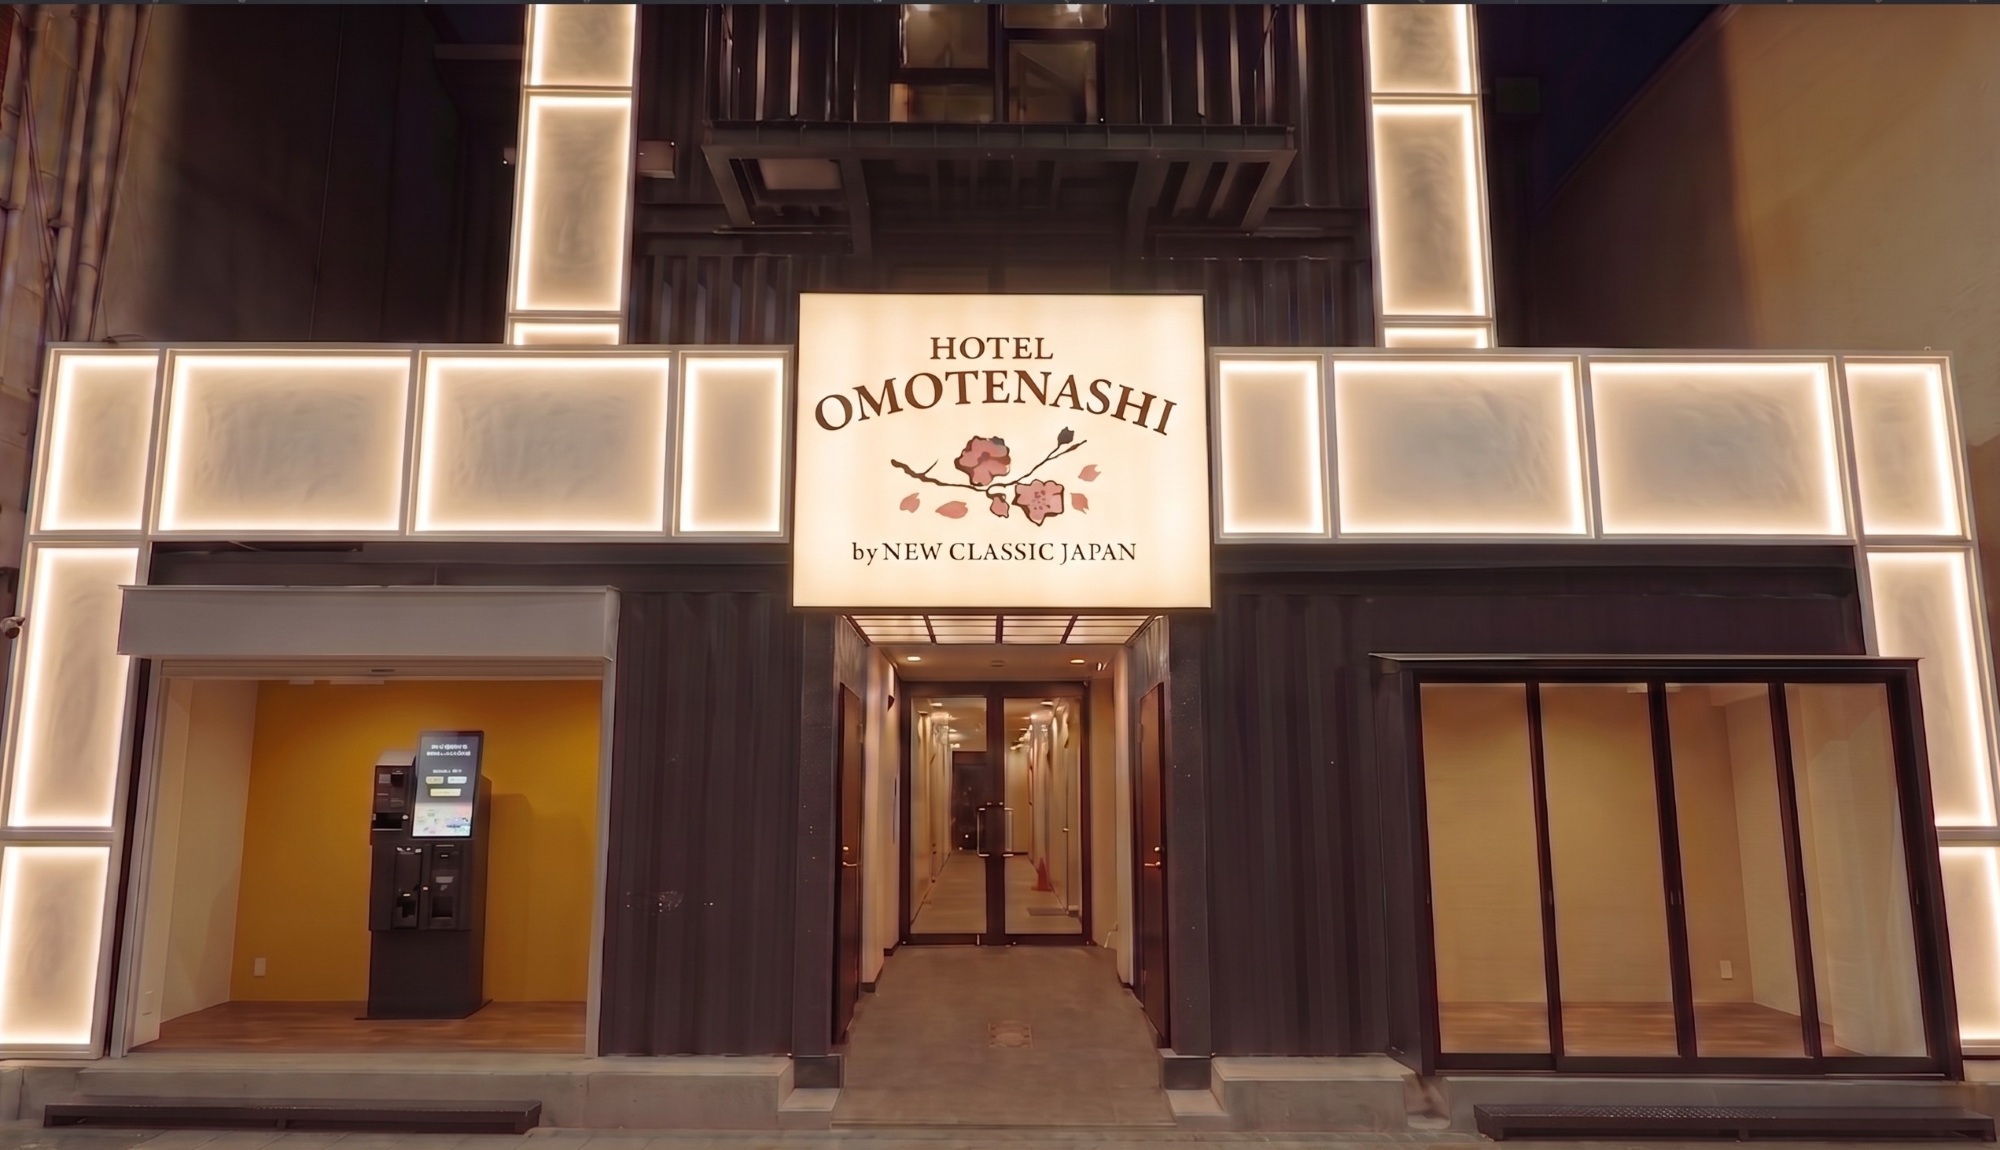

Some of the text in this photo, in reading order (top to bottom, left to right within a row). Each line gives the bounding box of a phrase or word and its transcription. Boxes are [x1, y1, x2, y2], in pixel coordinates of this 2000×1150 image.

[930, 337, 1054, 360] HOTEL
[815, 370, 1177, 436] OMOTENASHI
[853, 542, 1137, 566] by NEW CLASSIC JAPAN
